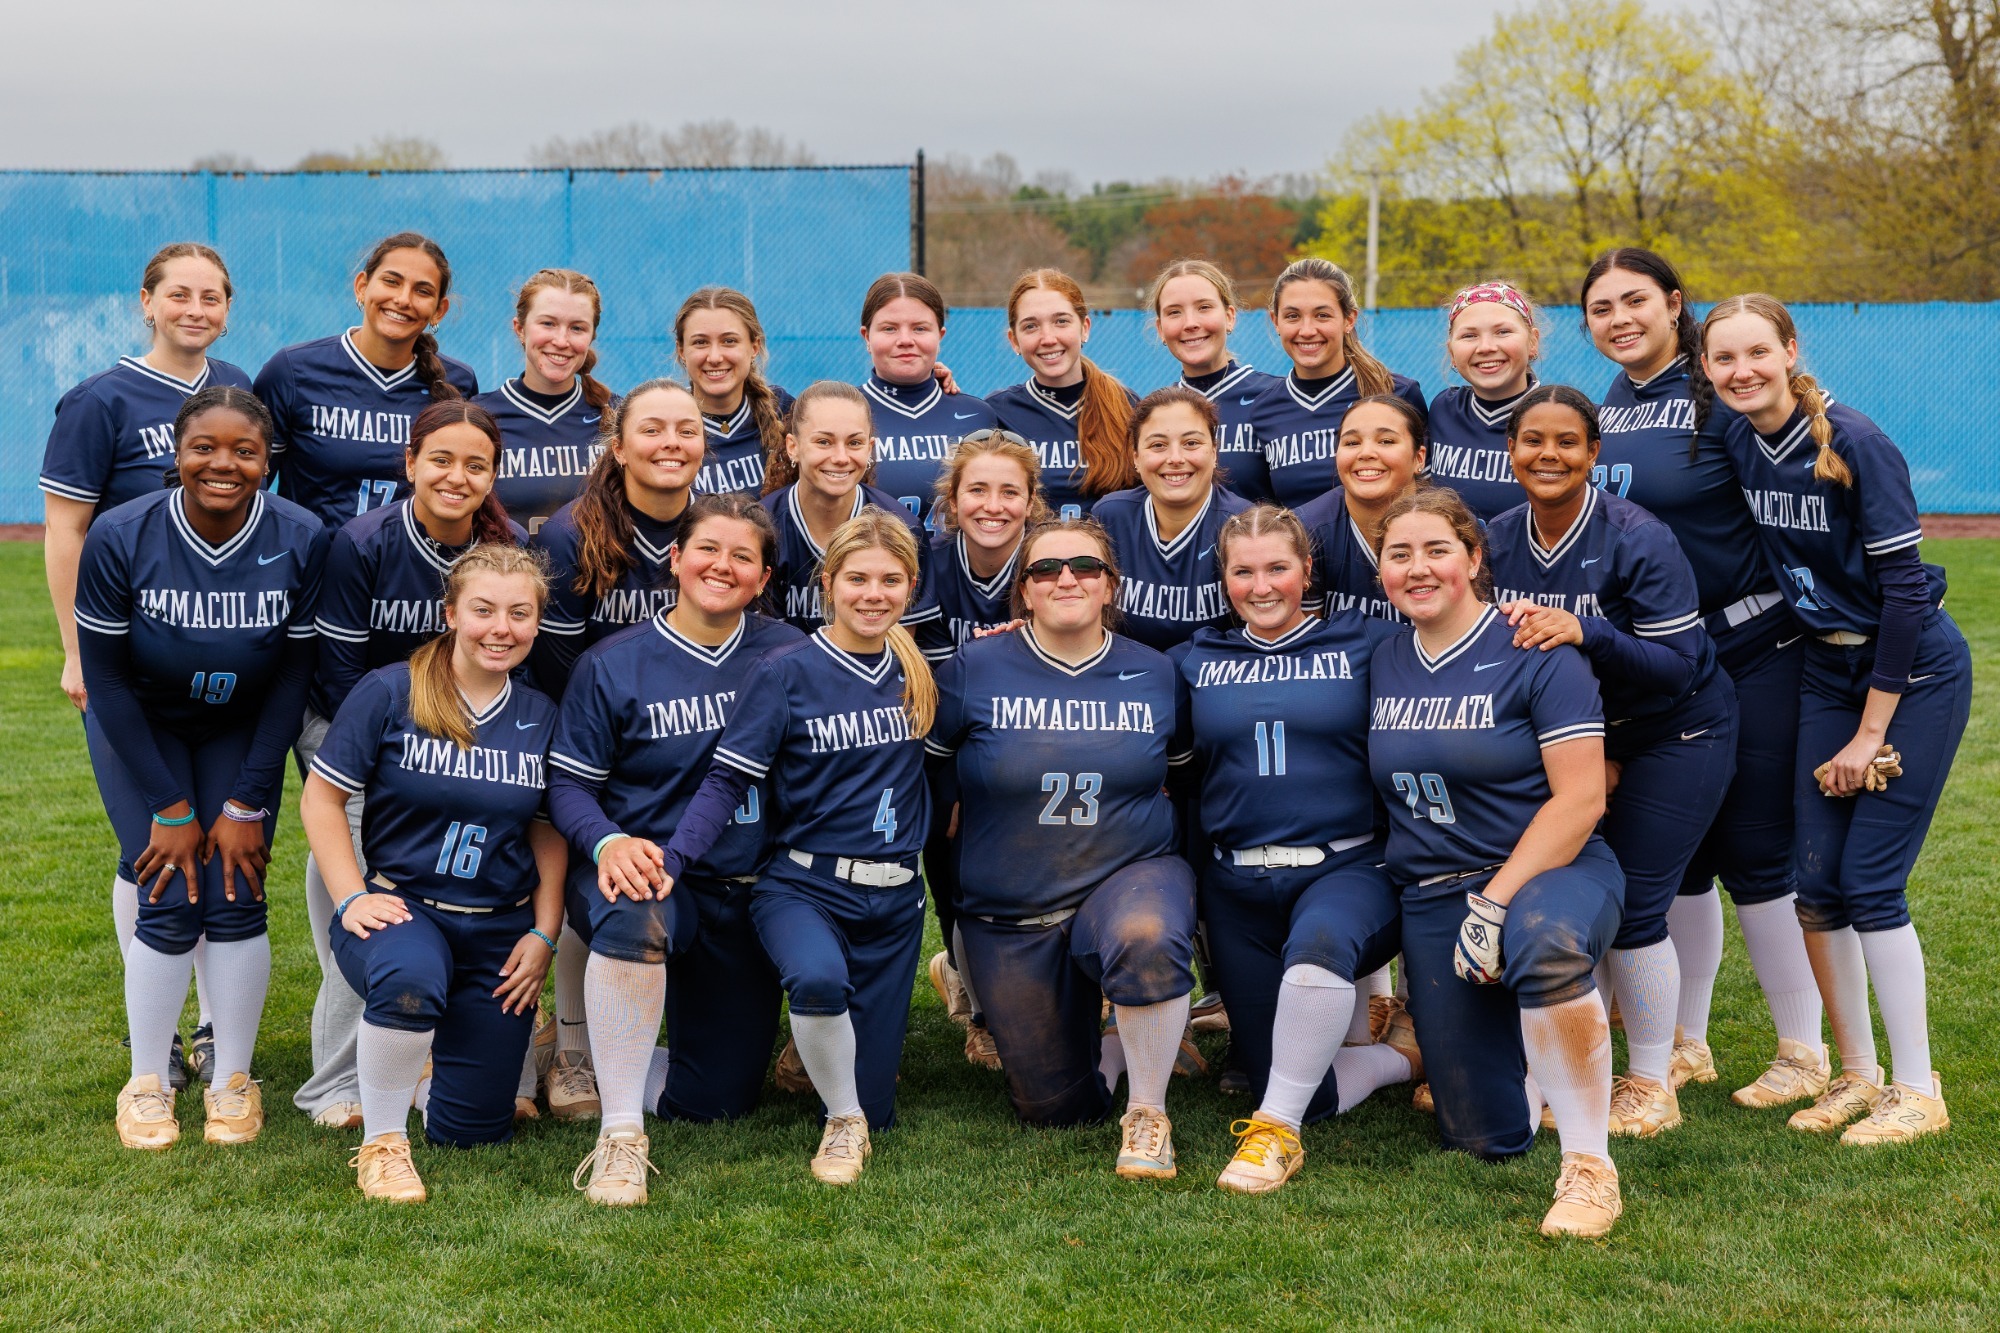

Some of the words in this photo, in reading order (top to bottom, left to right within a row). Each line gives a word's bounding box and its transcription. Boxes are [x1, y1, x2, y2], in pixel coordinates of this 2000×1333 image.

[1431, 442, 1519, 483] IMMACUL
[356, 479, 397, 516] 17
[140, 589, 290, 628] IMMACULATA
[370, 598, 446, 634] IMMAC
[190, 671, 237, 704] 19
[1196, 651, 1353, 688] IMMACULATA
[647, 691, 735, 739] IMMAC
[805, 706, 919, 753] IMMACUL
[991, 697, 1154, 734] IMMACULATA
[1371, 693, 1495, 730] IMMACULATA
[400, 733, 546, 789] IMMACULATA
[1255, 721, 1286, 776] 11
[873, 788, 897, 843] 4
[1038, 772, 1103, 826] 23
[1392, 772, 1456, 824] 29
[435, 821, 487, 879] 16
